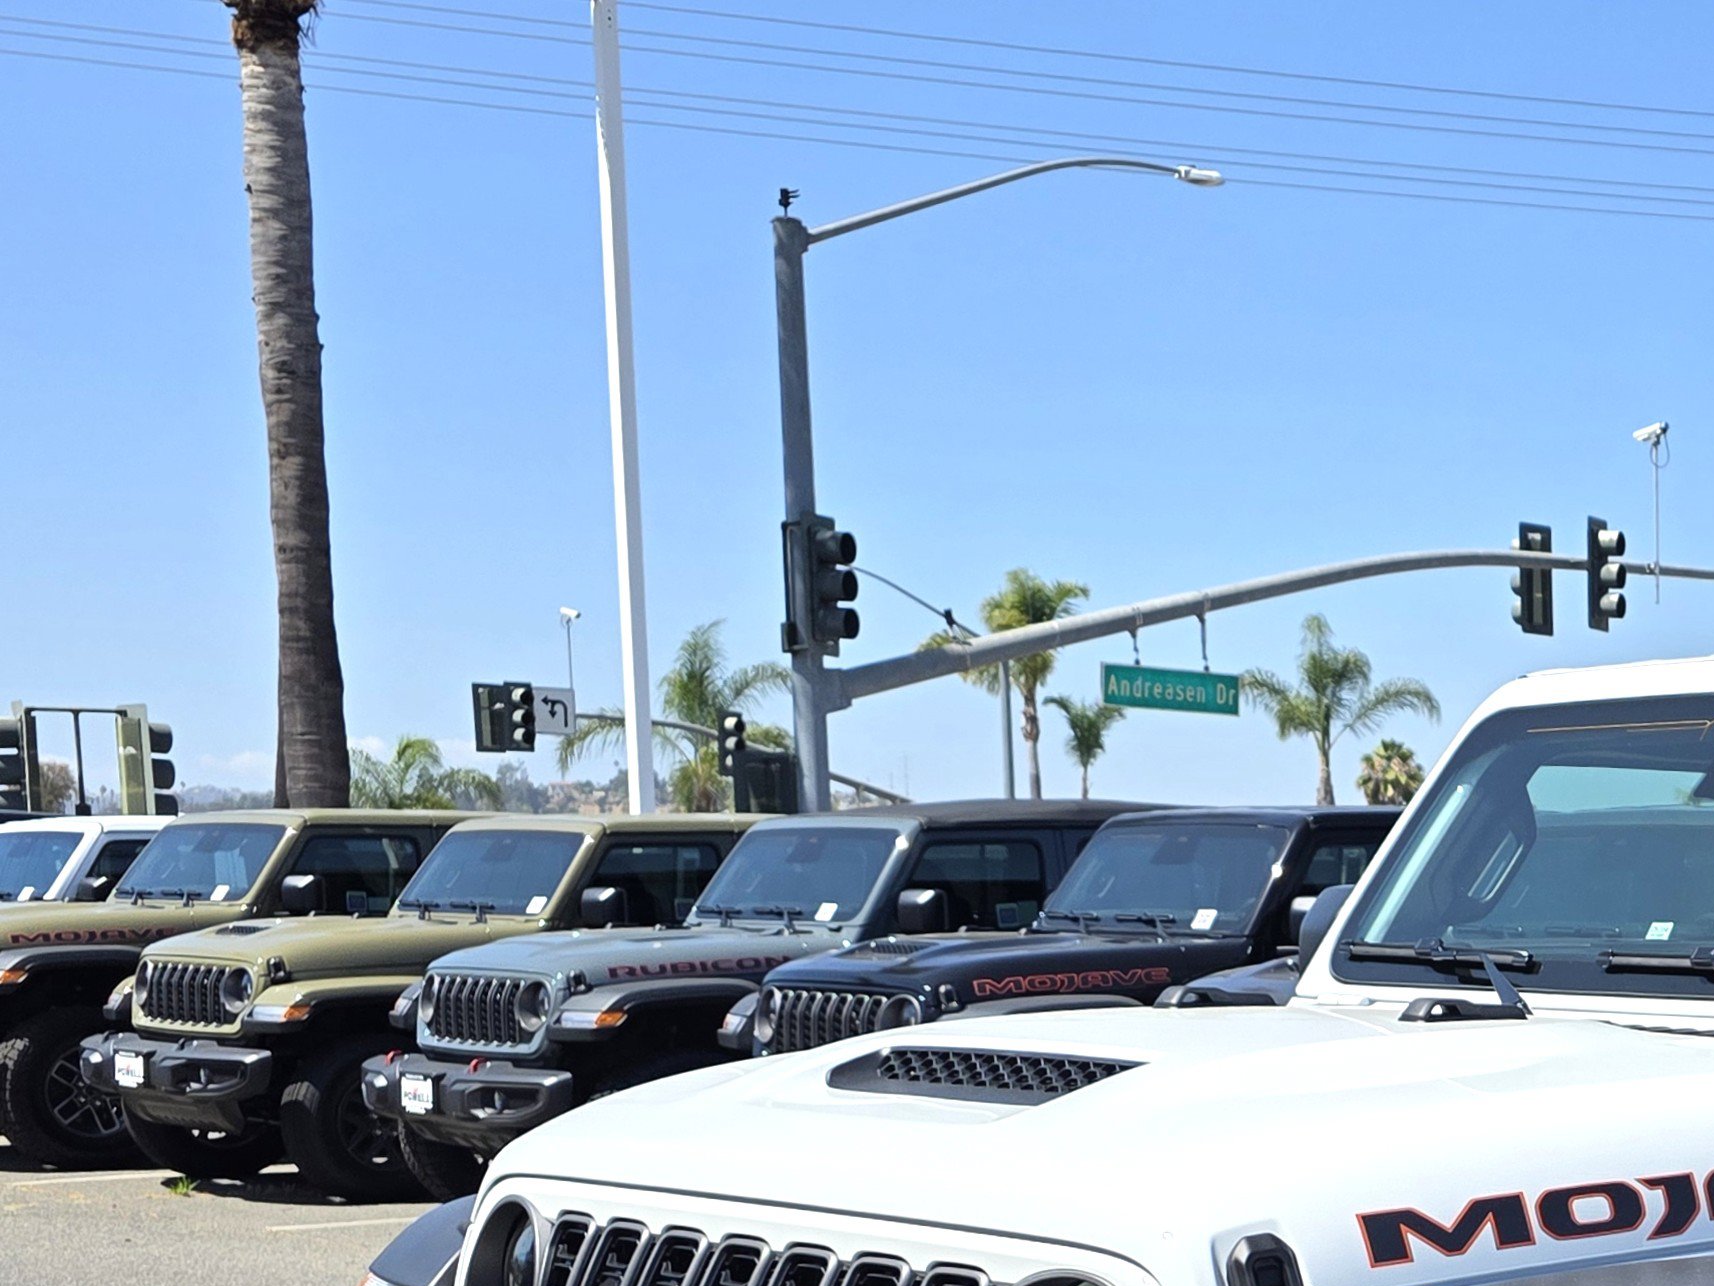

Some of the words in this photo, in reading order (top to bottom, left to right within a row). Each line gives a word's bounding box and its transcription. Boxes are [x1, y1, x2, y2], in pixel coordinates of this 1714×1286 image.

[1107, 674, 1206, 703] Andreasen
[1216, 684, 1237, 705] Dr
[973, 967, 1172, 996] MOJAVE
